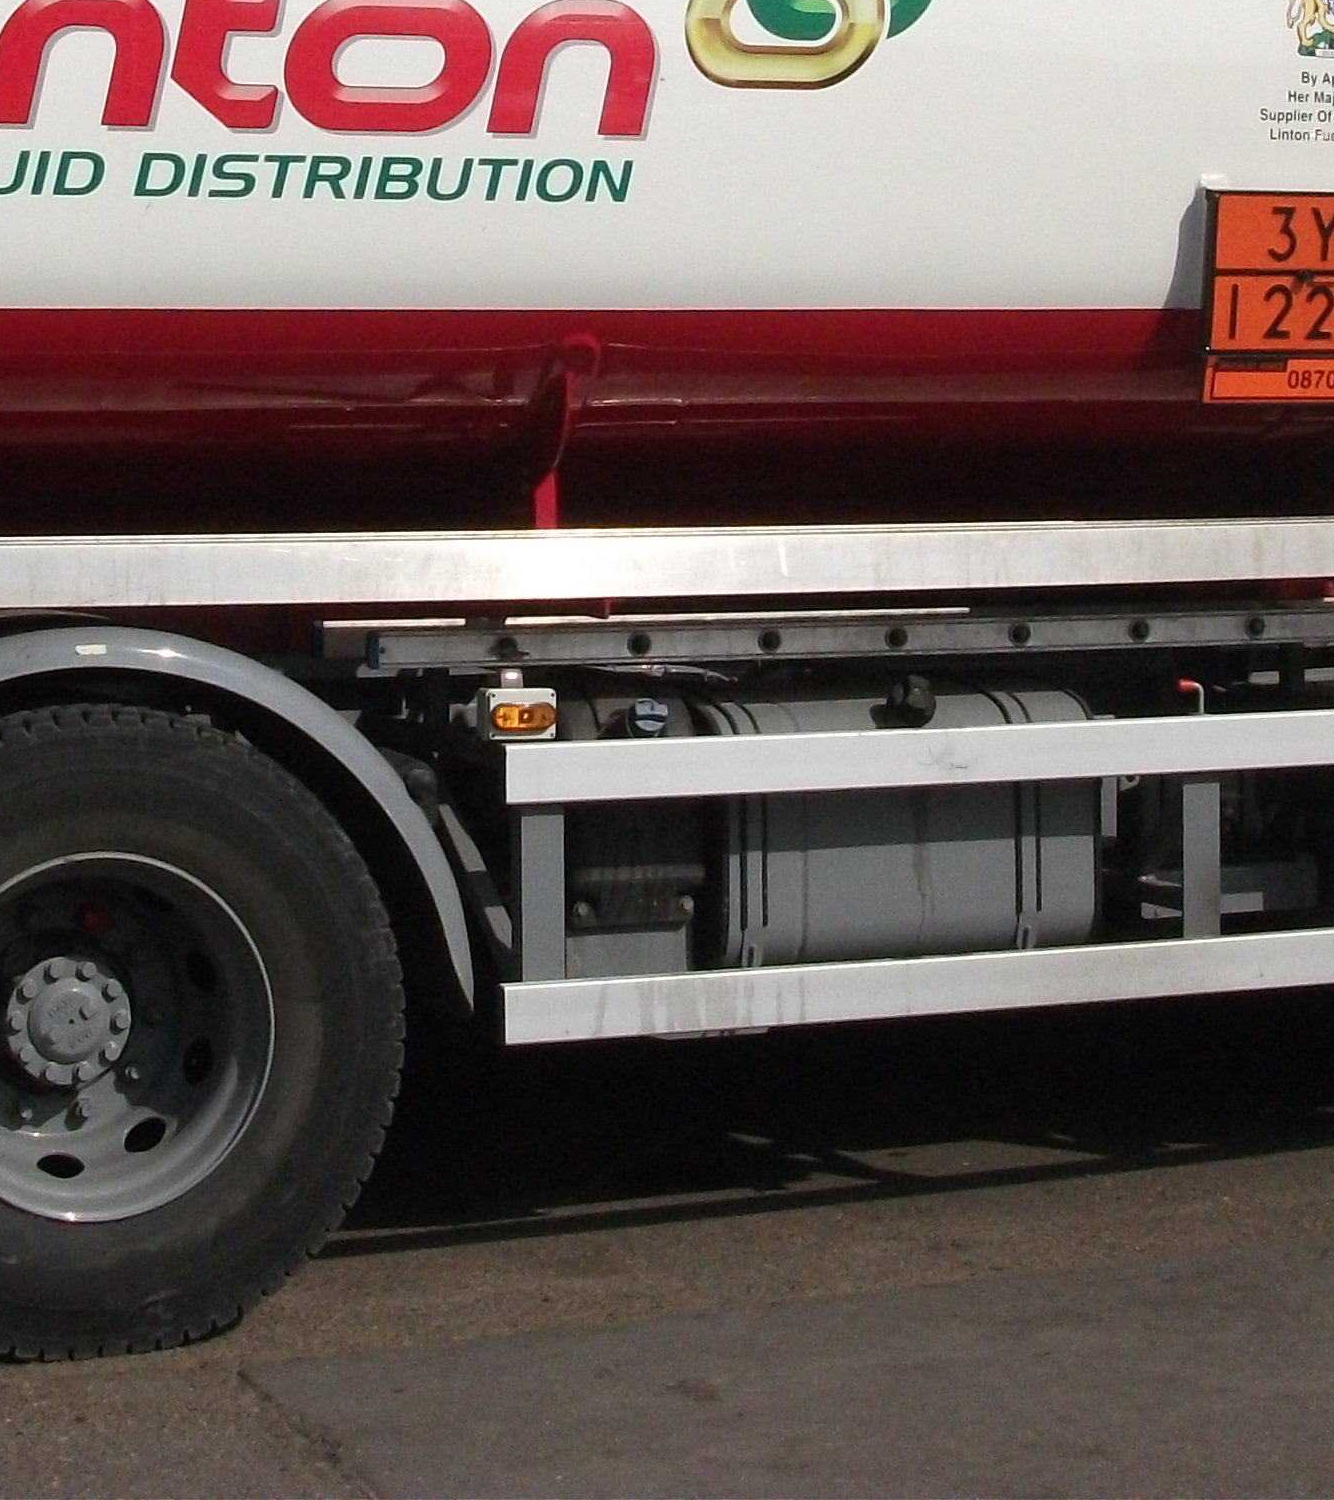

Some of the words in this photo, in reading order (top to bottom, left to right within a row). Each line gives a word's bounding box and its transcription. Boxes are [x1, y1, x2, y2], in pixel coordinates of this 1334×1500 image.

[1300, 71, 1318, 87] By
[1287, 90, 1310, 103] Her
[1260, 108, 1313, 124] Supplier
[1317, 110, 1333, 122] Of
[1269, 128, 1310, 141] Linton
[133, 151, 634, 203] DISTRIBUTION
